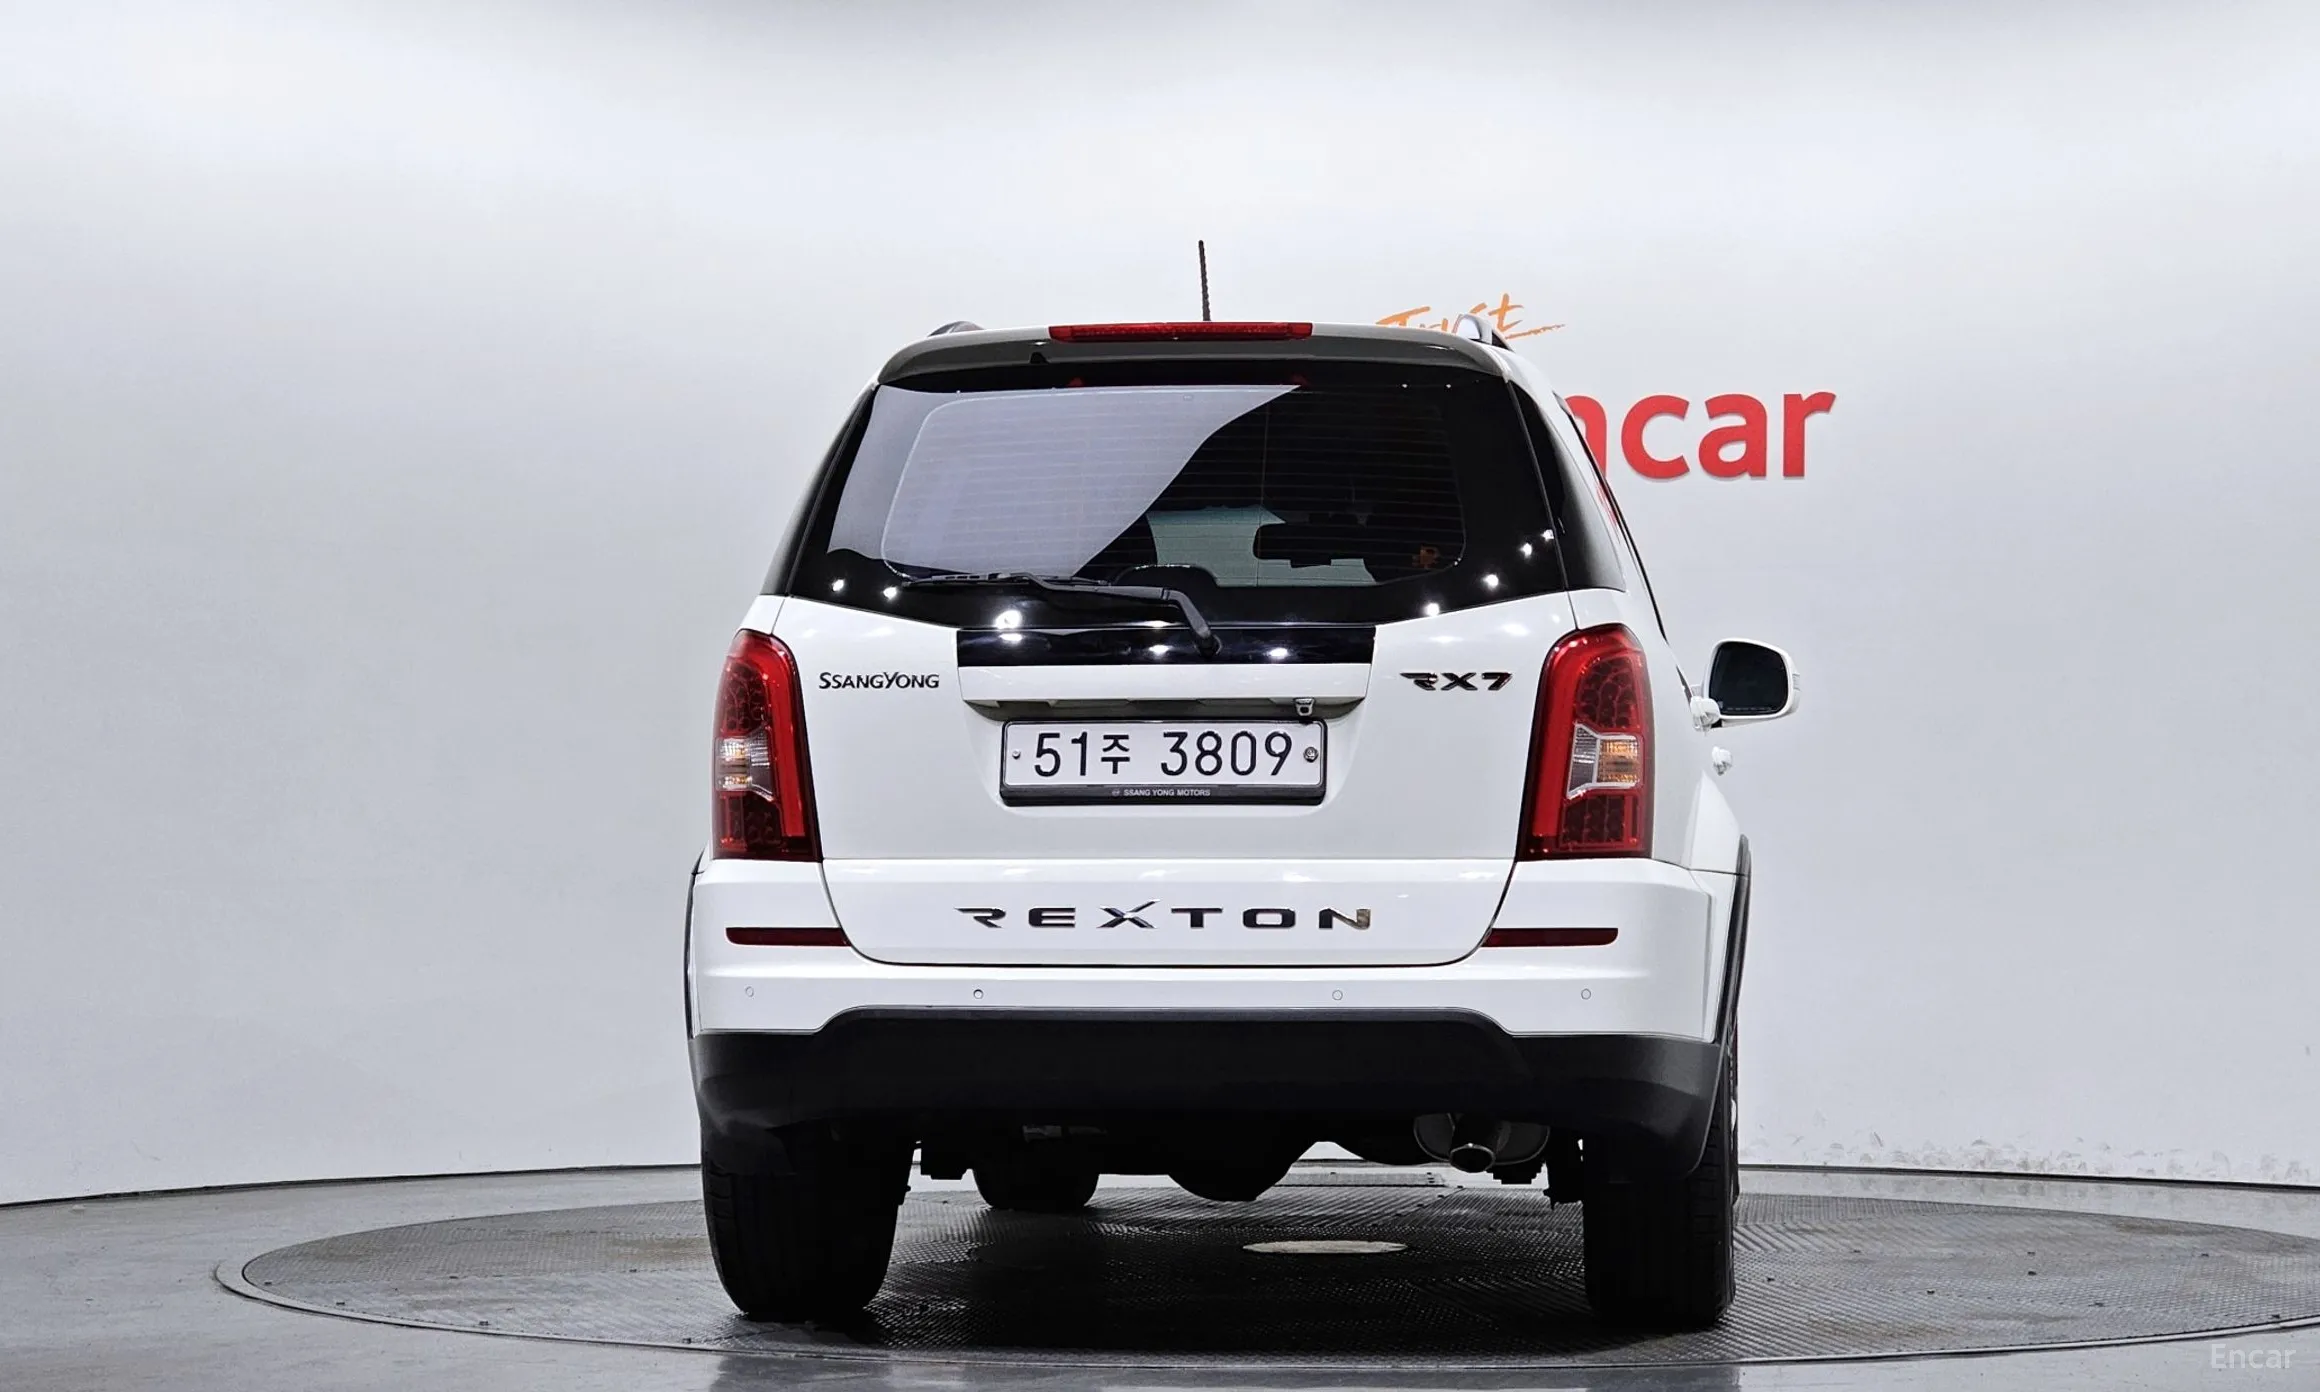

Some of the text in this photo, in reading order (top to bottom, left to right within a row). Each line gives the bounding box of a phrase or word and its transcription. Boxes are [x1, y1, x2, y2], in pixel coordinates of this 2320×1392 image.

[1399, 672, 1513, 691] RX7
[1033, 730, 1293, 778] 51주 3809
[1123, 788, 1211, 797] SSANG YONG MOTORS
[953, 898, 1372, 930] REXTON
